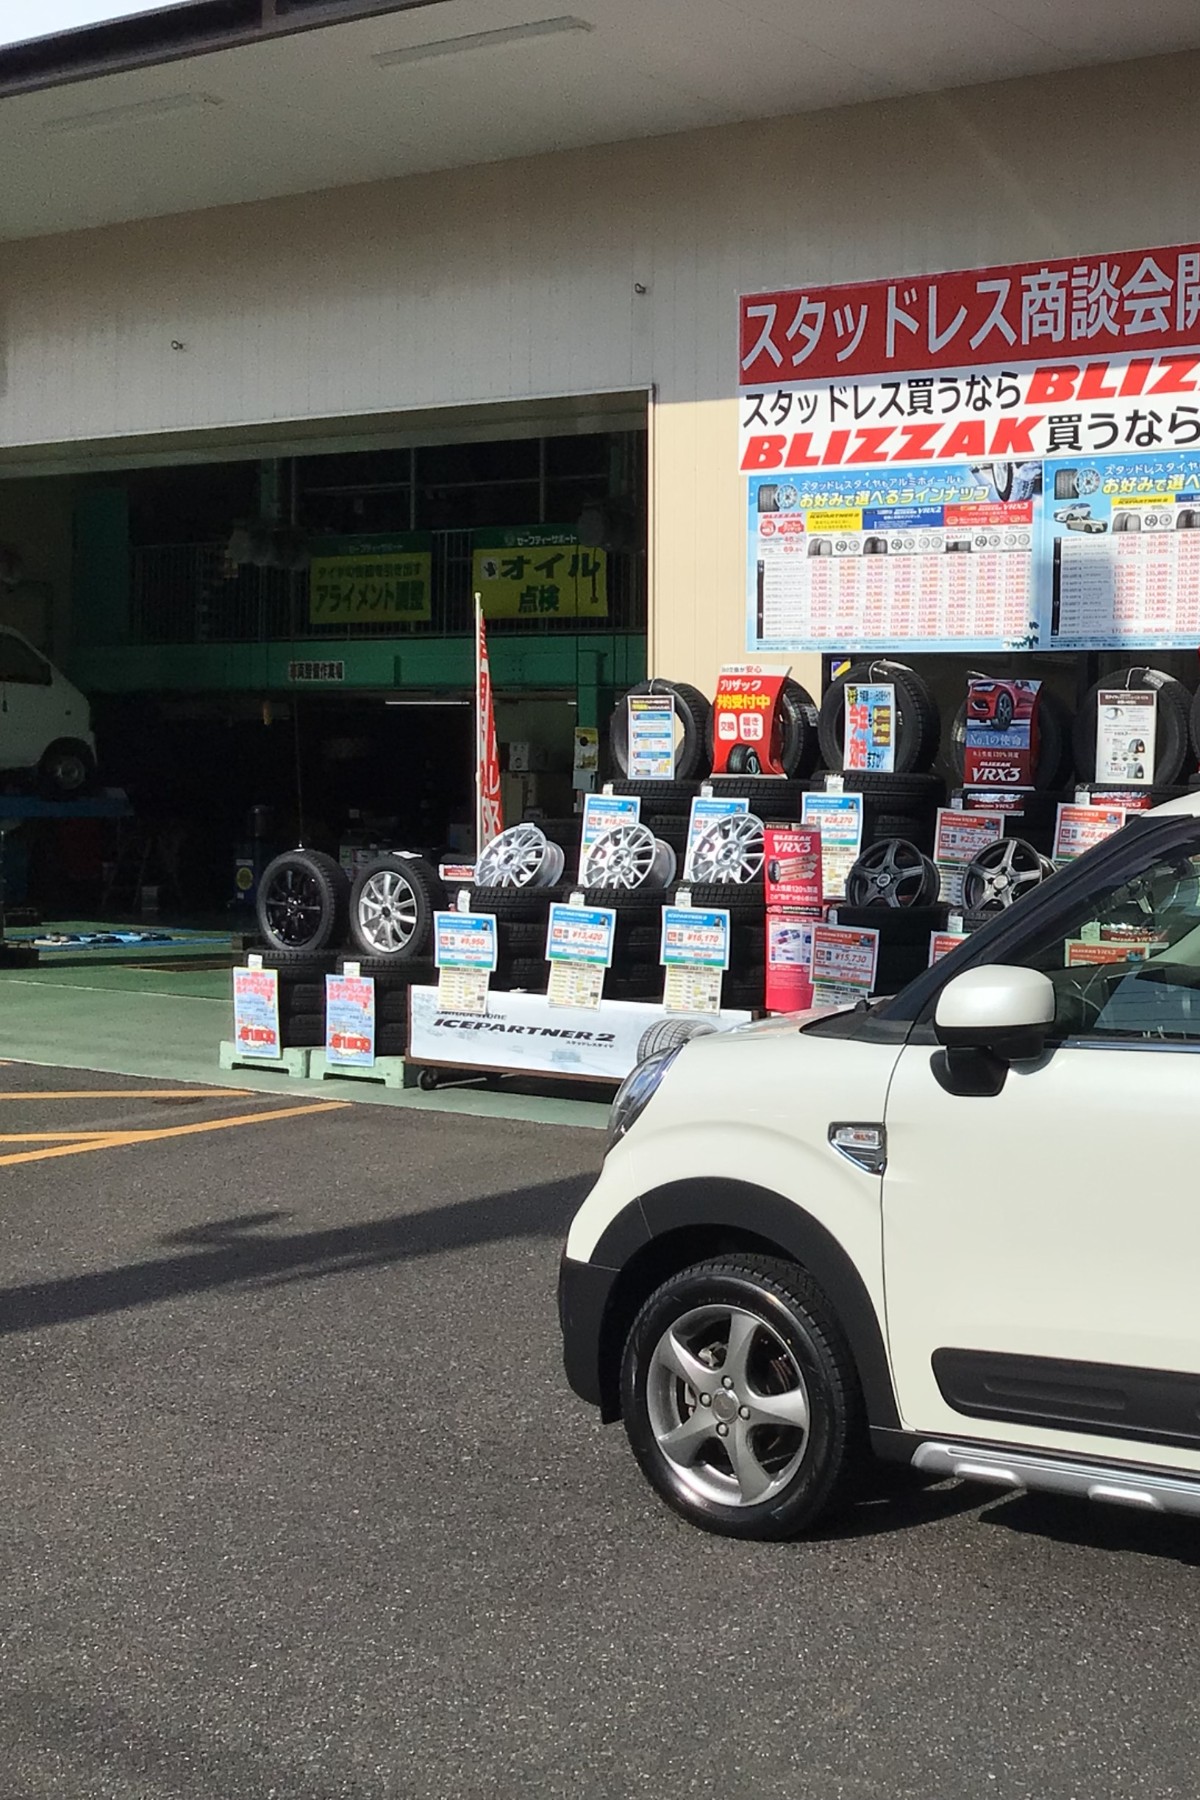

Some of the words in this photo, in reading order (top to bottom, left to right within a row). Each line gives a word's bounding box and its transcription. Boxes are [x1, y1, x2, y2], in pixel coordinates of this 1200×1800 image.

[740, 416, 1049, 470] BLIZZAK
[800, 485, 990, 508] お好みで選べるラインナップ
[501, 553, 601, 581] オイル
[518, 584, 560, 613] 点検
[720, 721, 735, 732] 交換
[971, 767, 1021, 782] VRX3
[773, 842, 811, 853] VRX3
[433, 1018, 595, 1041] ICEPARTNER
[595, 1032, 616, 1042] 2
